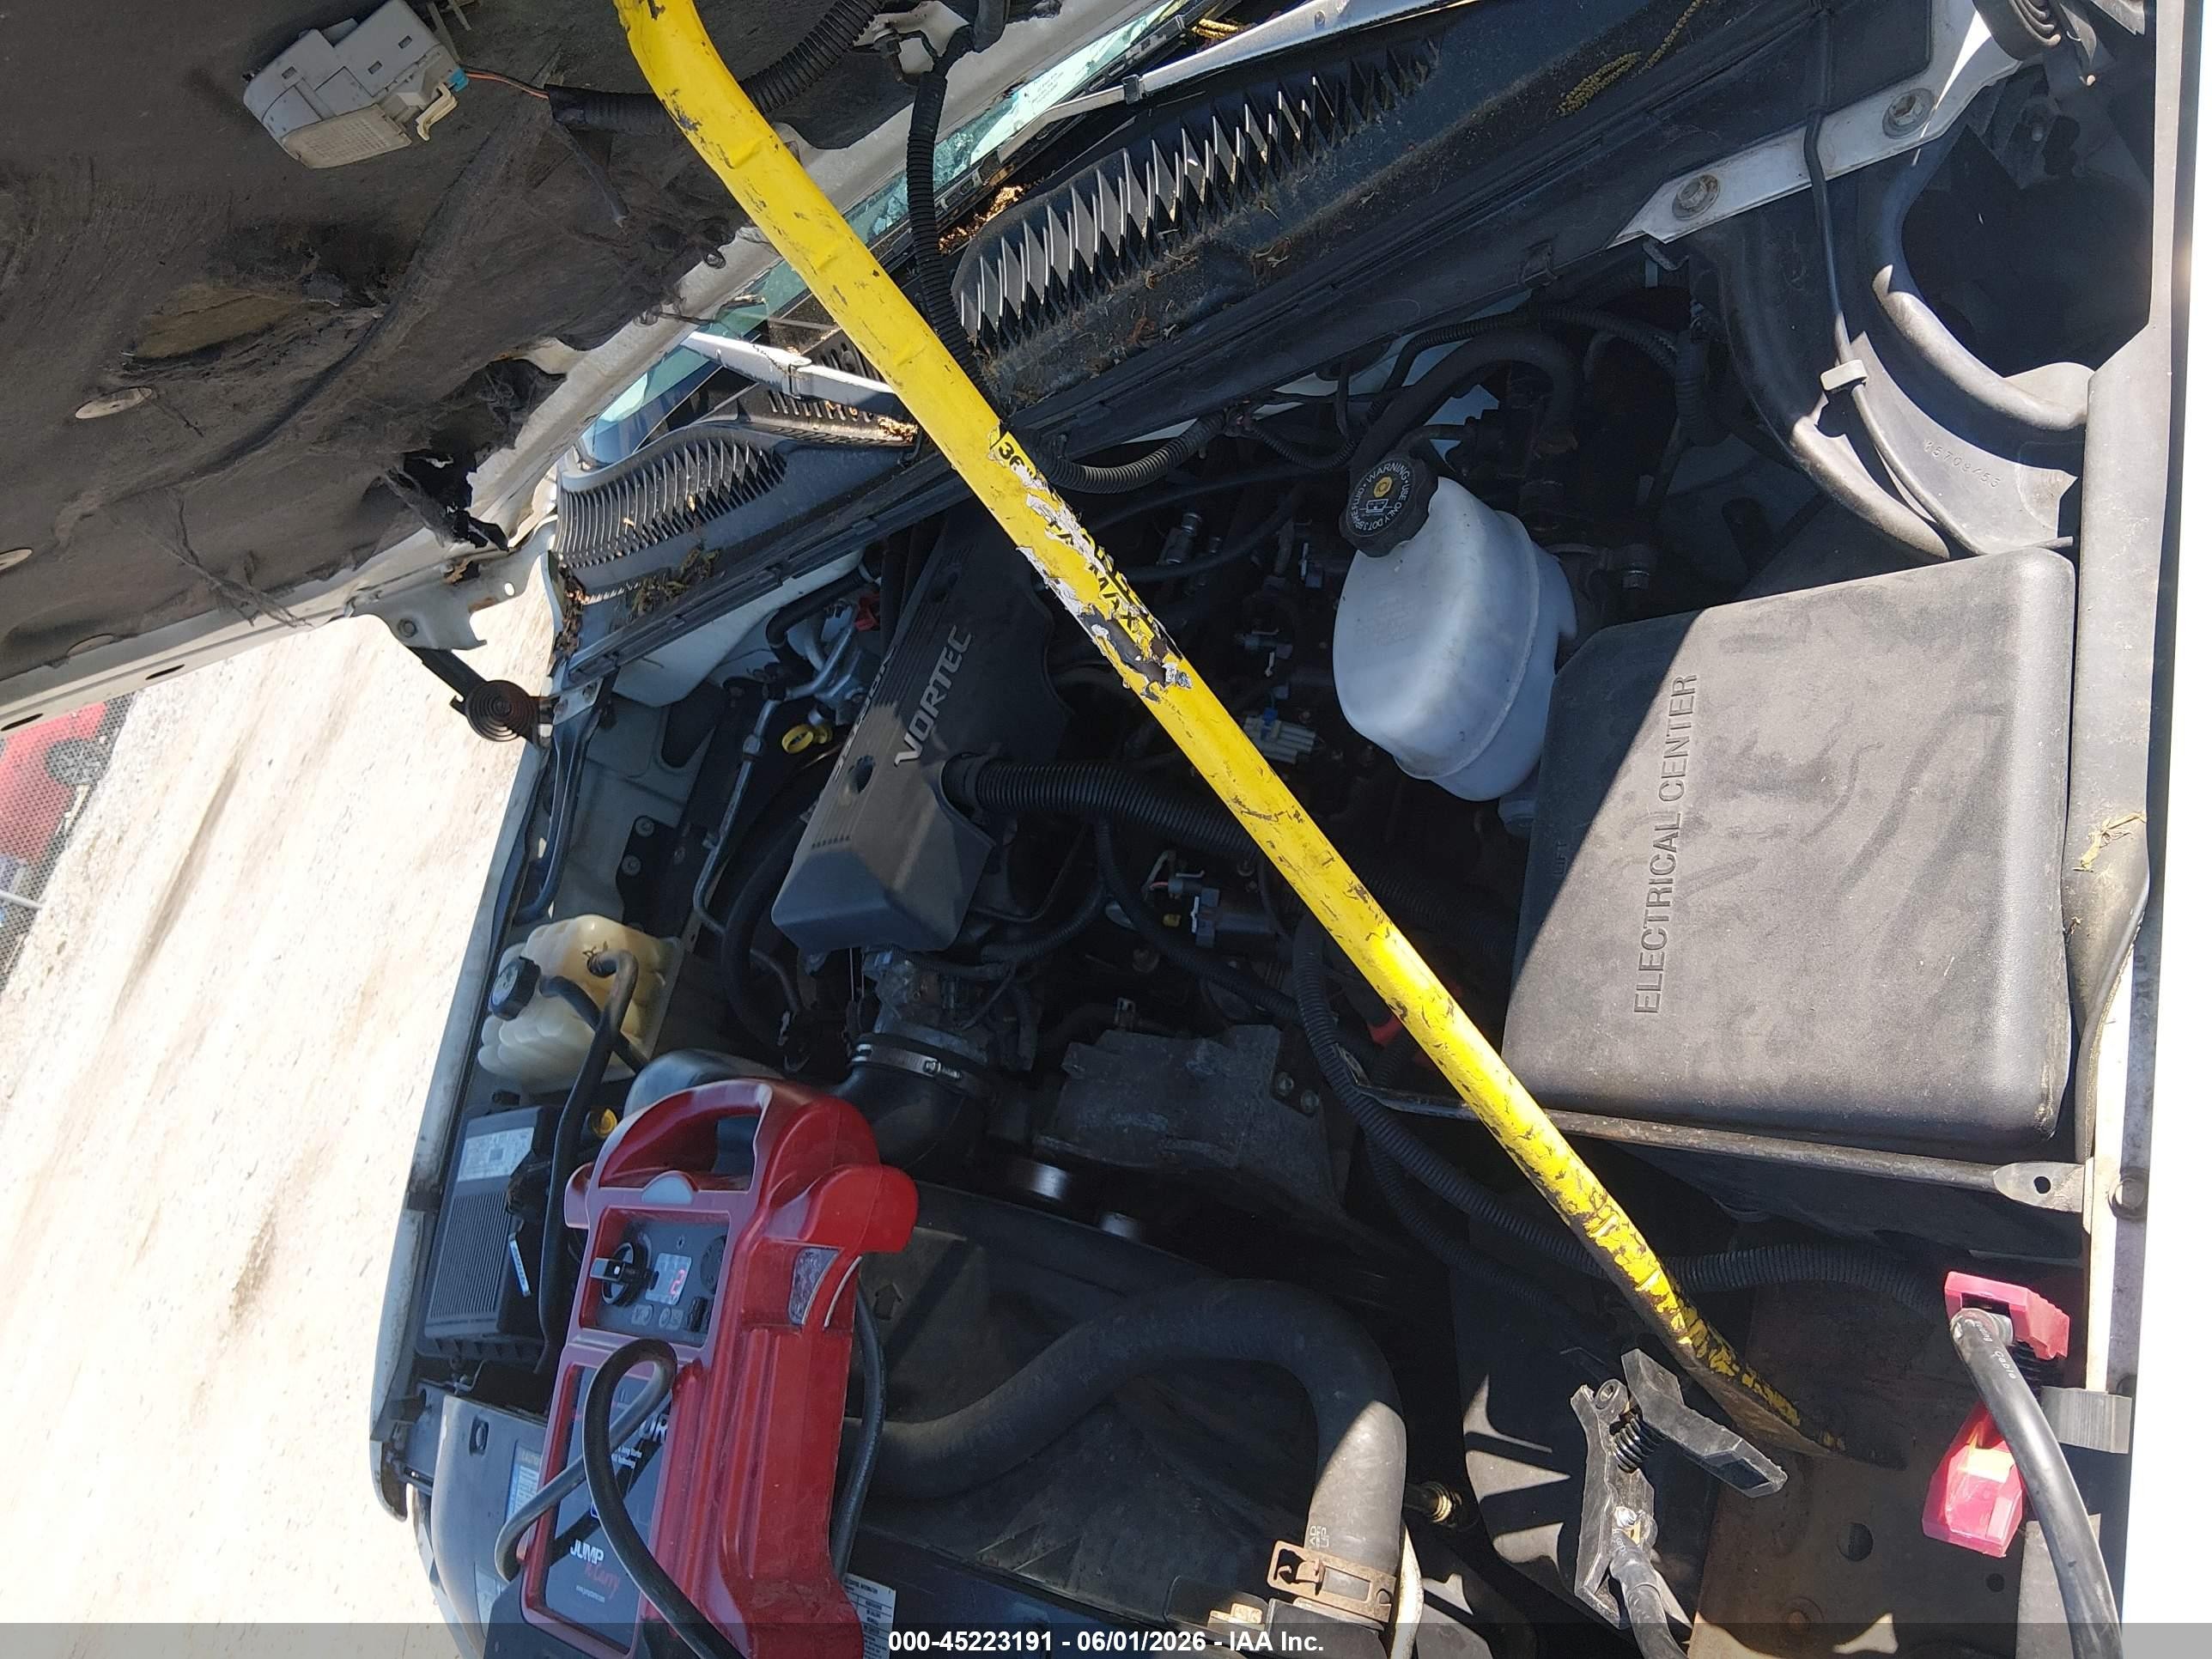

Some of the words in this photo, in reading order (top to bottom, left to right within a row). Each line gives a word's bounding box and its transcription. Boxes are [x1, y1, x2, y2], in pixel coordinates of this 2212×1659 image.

[1365, 462, 1410, 483] WARNING
[1398, 483, 1410, 501] USE
[1384, 501, 1402, 523] ONLY
[894, 624, 973, 767] VORTEC
[1633, 812, 1681, 1014] ELECTRICAL
[1658, 673, 1698, 803] CENTER
[1994, 1350, 2017, 1380] Cable
[569, 1538, 605, 1565] JUMP
